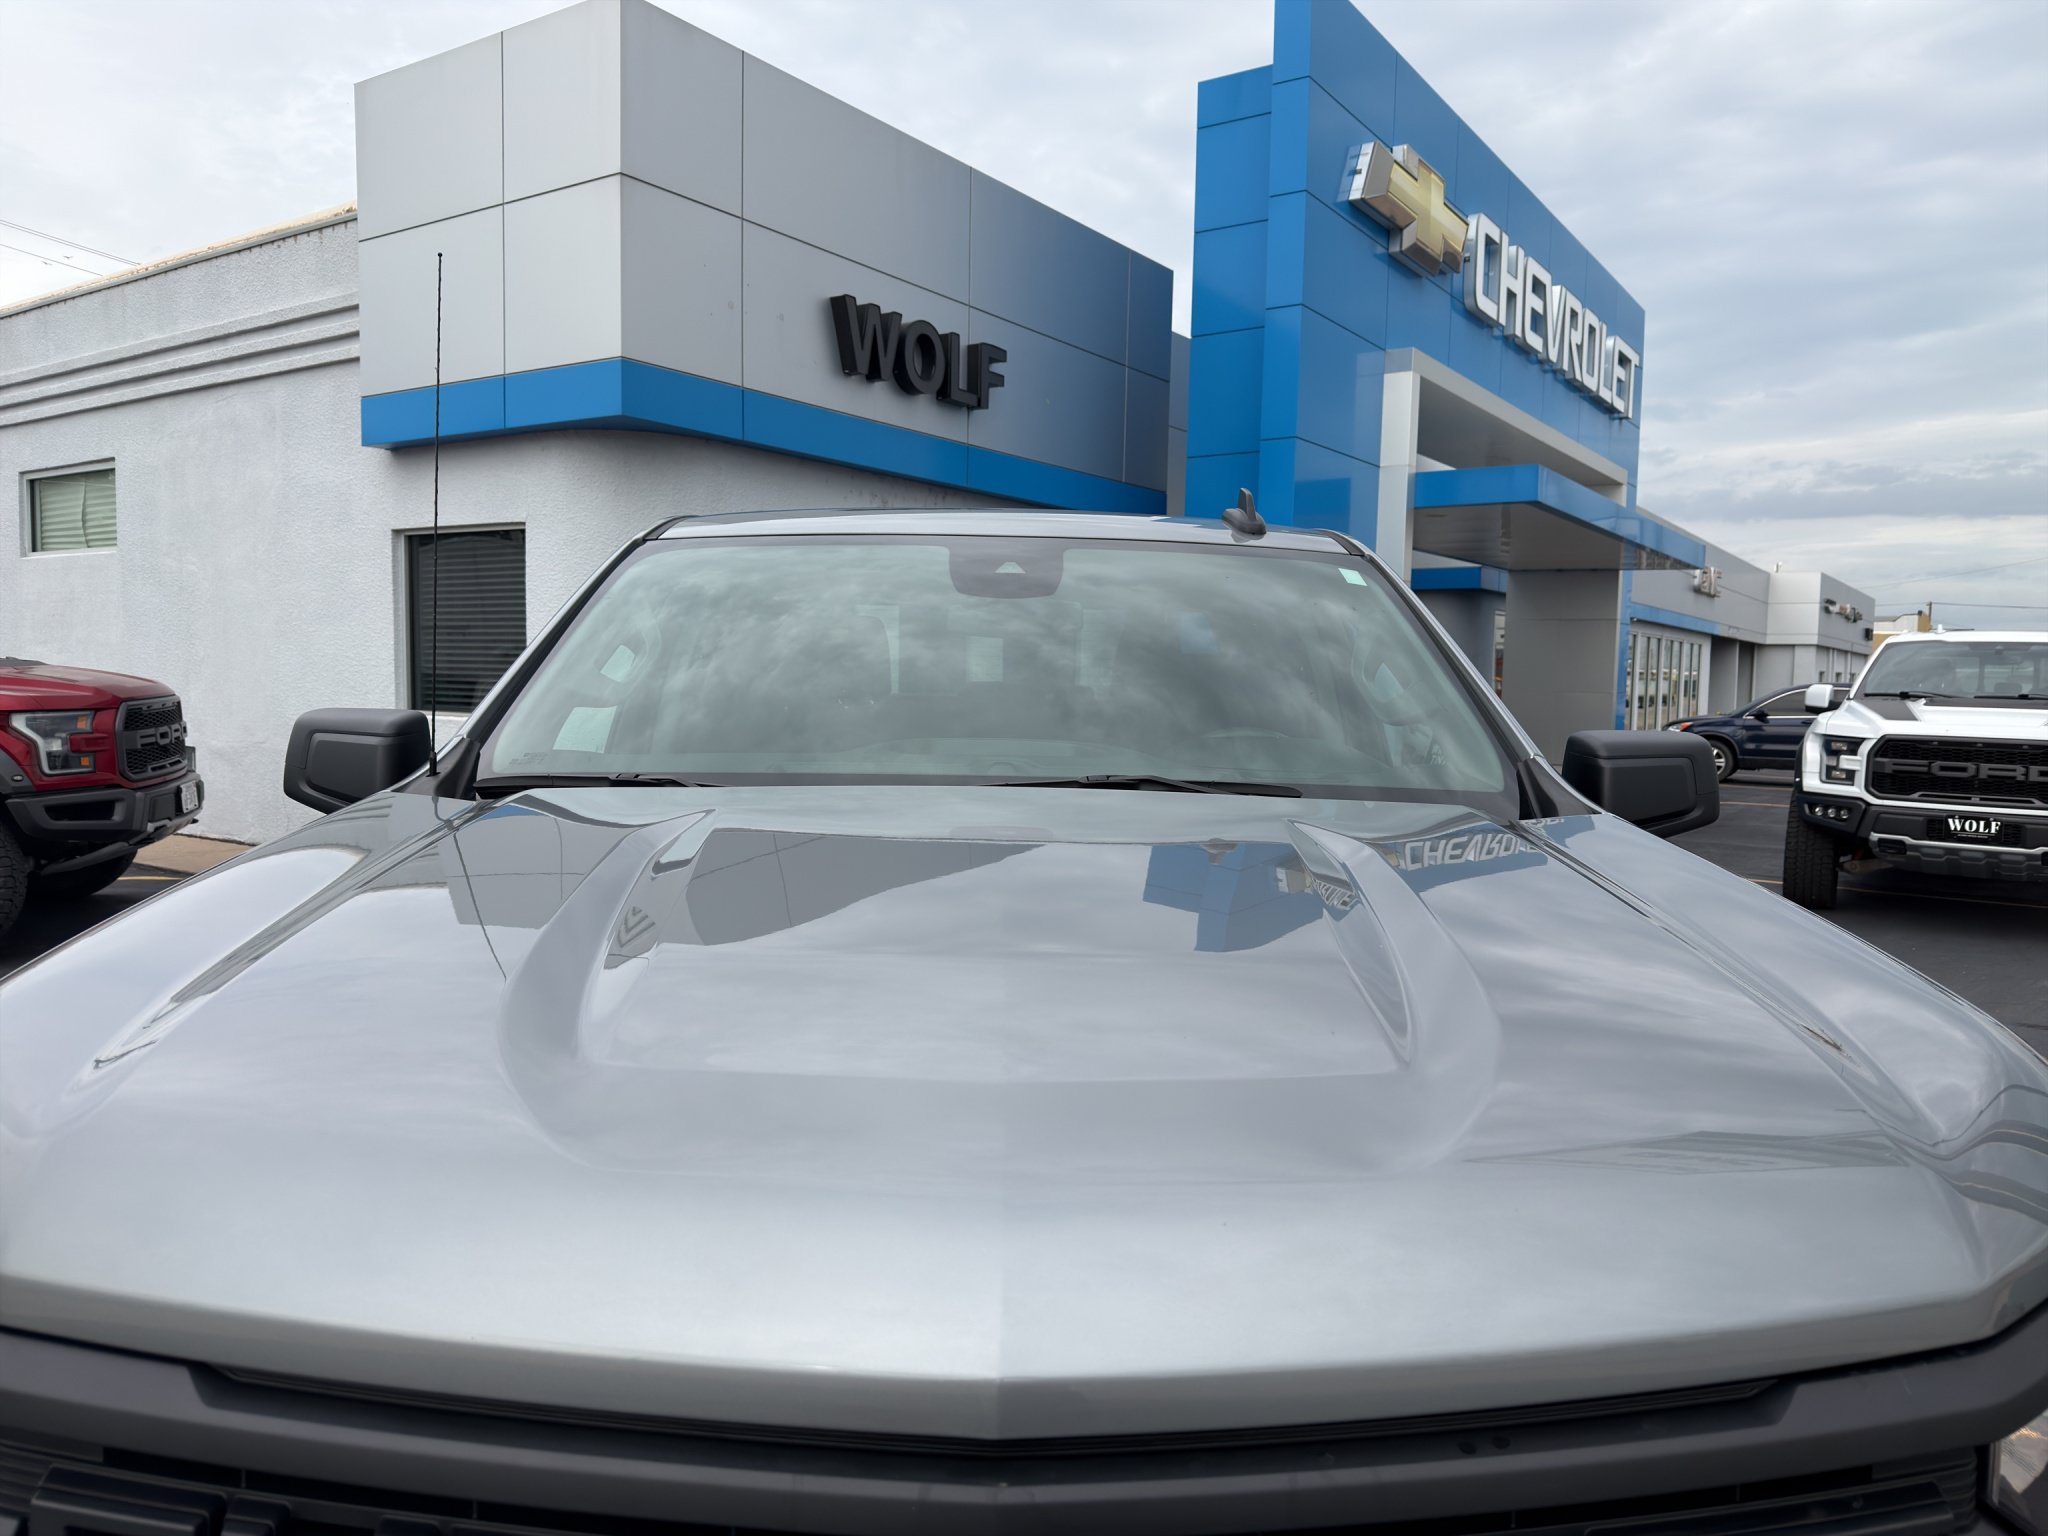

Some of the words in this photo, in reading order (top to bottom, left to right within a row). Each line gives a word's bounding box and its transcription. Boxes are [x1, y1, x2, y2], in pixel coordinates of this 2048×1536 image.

[1463, 212, 1640, 419] CHEVROLET
[830, 294, 1007, 409] WOLF
[137, 721, 187, 748] FORD
[1947, 818, 2001, 834] WOLF
